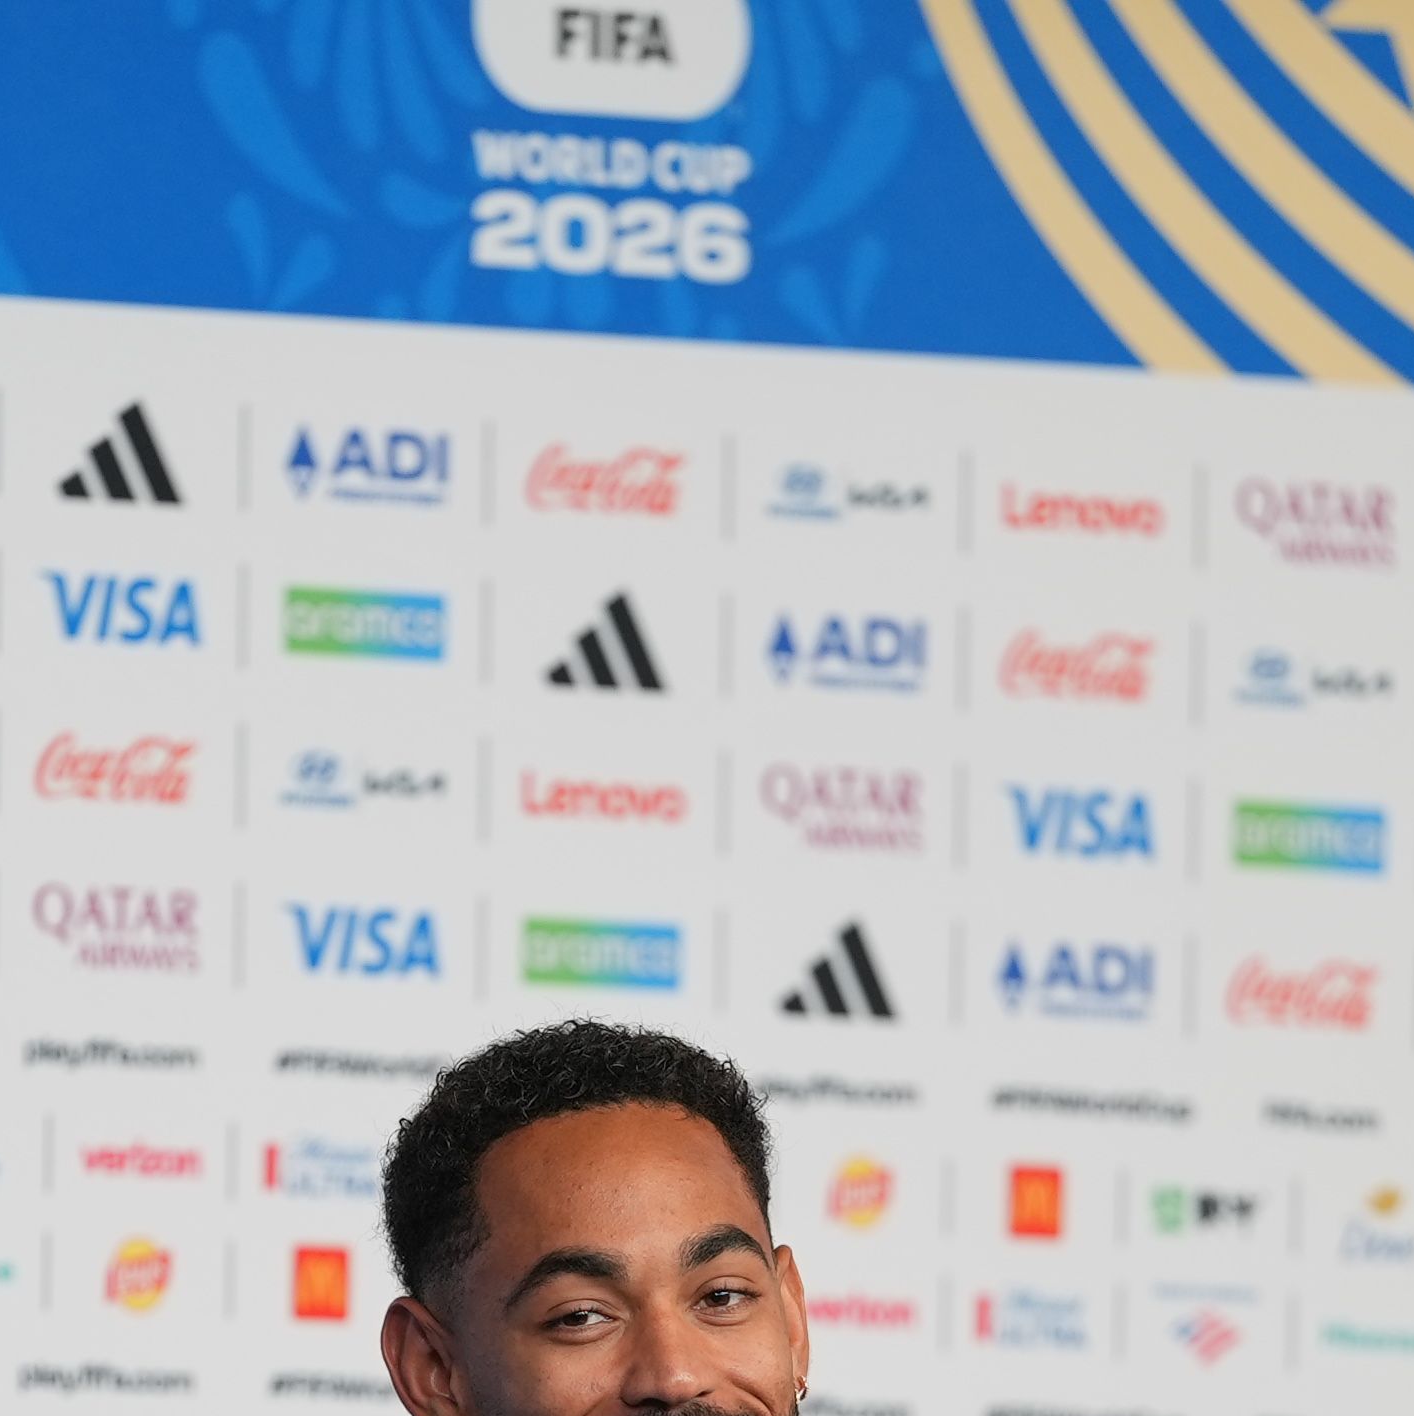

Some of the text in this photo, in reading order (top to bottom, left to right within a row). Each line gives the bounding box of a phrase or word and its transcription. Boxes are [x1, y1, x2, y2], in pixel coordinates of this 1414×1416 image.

[557, 8, 672, 63] FIFA
[473, 132, 751, 193] WORLD CUP
[472, 185, 749, 282] 2026
[333, 430, 447, 481] ADI
[1003, 490, 1162, 535] Lenovo
[50, 573, 200, 645] VISA
[812, 617, 925, 669] ADI
[34, 733, 194, 805] Coca-Cola
[523, 776, 685, 822] Lenovo
[1011, 788, 1154, 857] VISA
[33, 885, 196, 950] QATAR
[292, 905, 440, 976] VISA
[1042, 945, 1152, 998] ADI
[84, 1145, 200, 1176] verizon
